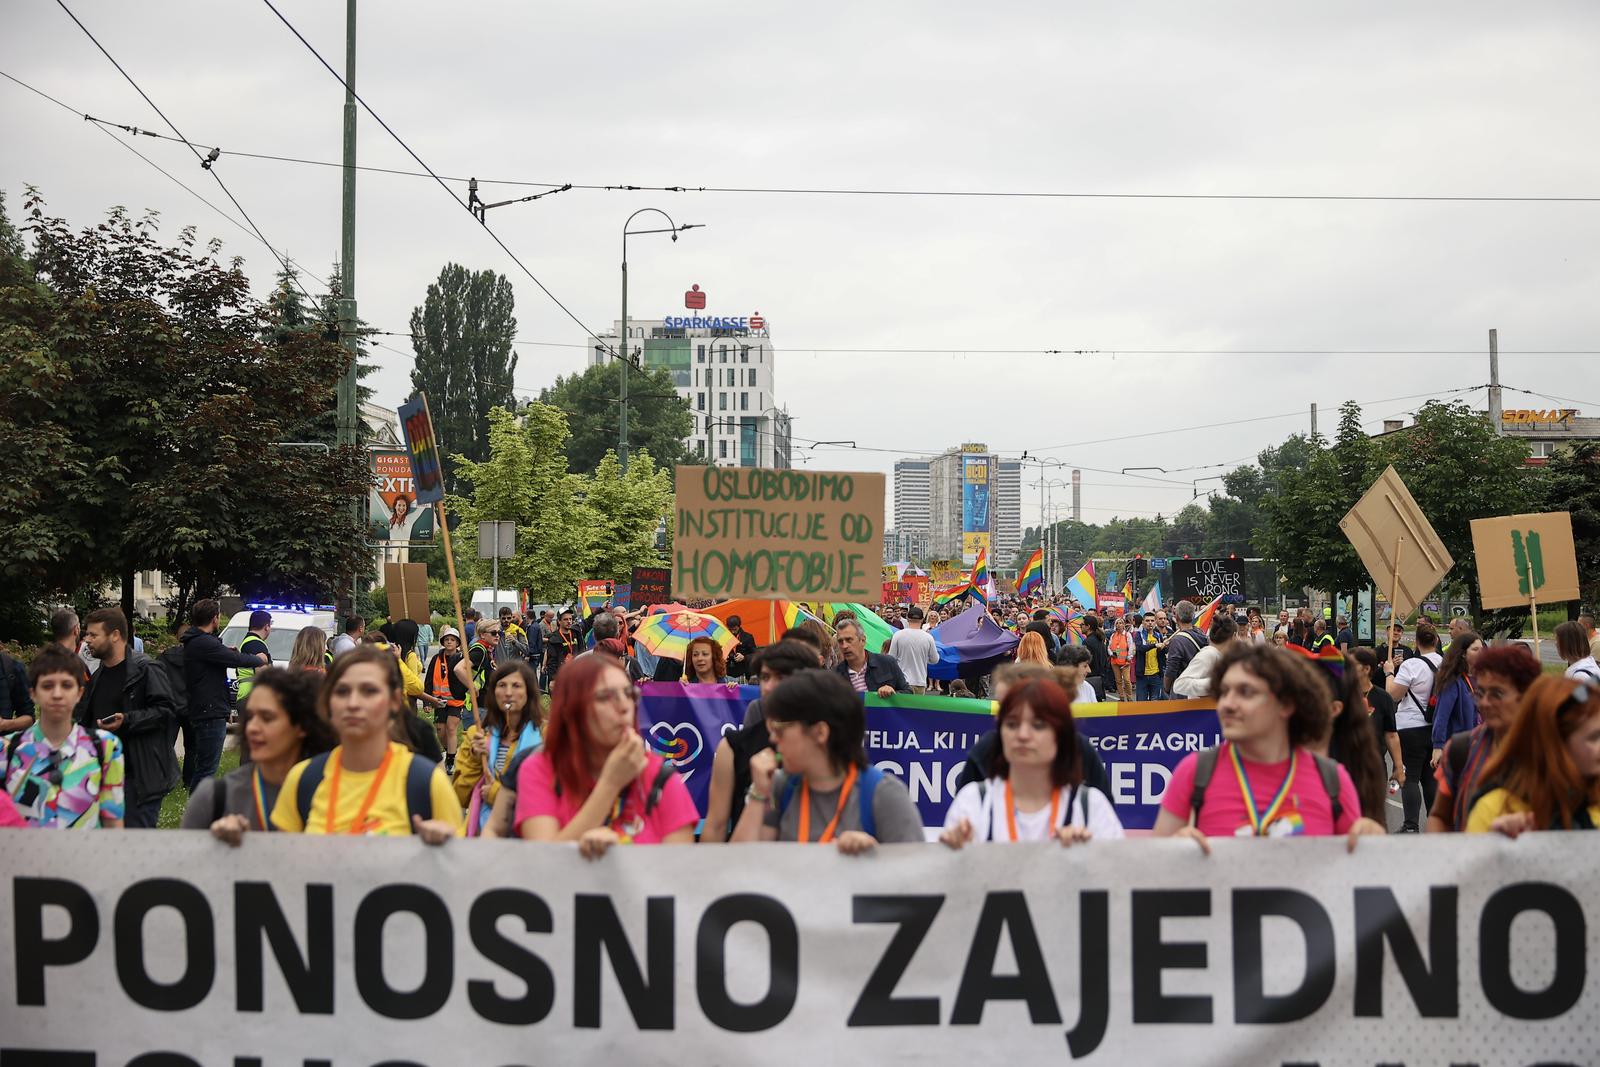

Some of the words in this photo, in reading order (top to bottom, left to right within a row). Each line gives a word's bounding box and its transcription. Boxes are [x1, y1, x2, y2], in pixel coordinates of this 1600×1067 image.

[665, 316, 748, 329] SPARKASSE
[703, 467, 854, 502] OSLOBODIMO
[678, 508, 829, 541] INSTITUCIJE
[840, 513, 873, 544] OD
[676, 548, 869, 595] HOMOFOBIJE
[1195, 560, 1227, 574] LOVE
[1187, 576, 1198, 588] IS
[1204, 572, 1241, 585] NEVER
[1195, 584, 1239, 596] WRONG
[862, 730, 955, 754] ELJA_KI
[12, 875, 800, 1033] PONOSNO
[846, 880, 1587, 1060] ZAJEDNO
